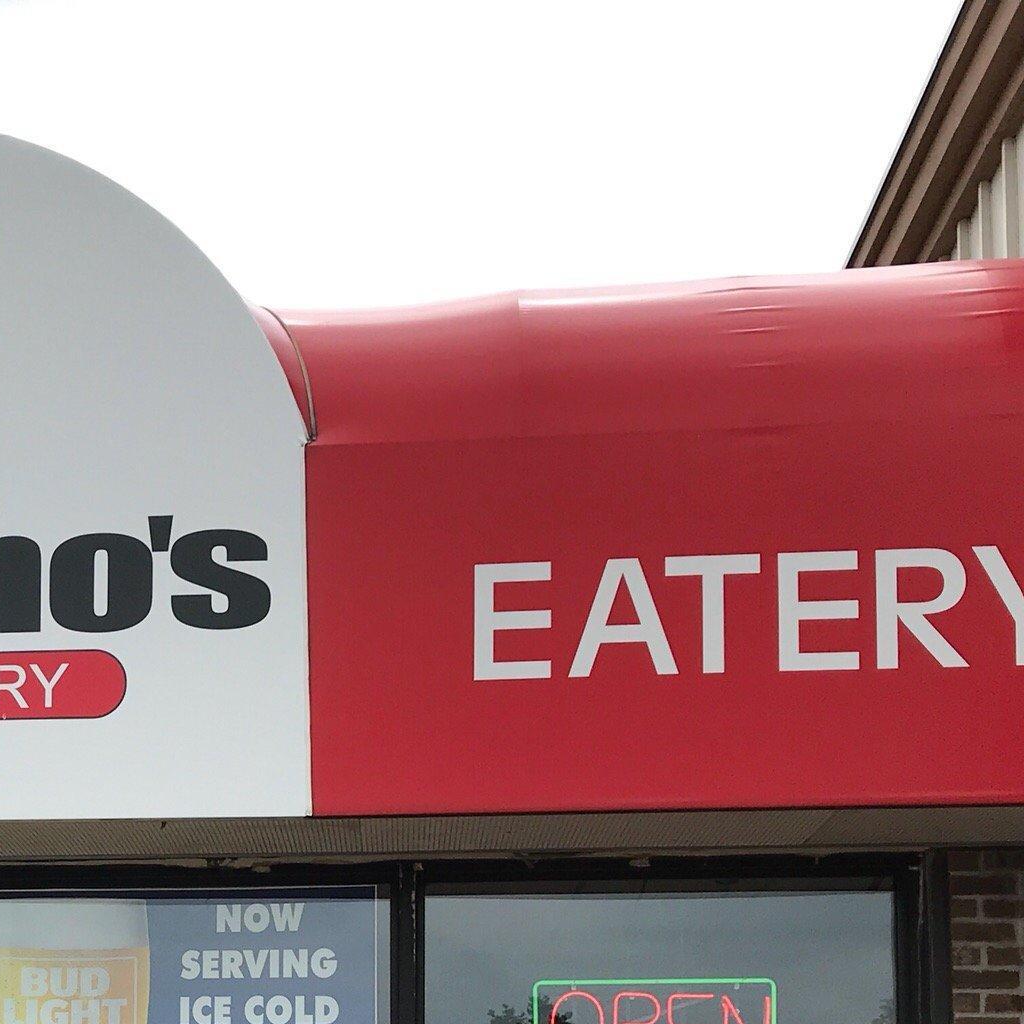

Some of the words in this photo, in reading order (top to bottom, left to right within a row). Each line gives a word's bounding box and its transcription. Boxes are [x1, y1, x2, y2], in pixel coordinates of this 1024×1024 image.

[215, 902, 306, 933] NOW
[180, 949, 338, 979] SERVING
[20, 966, 111, 998] BUD
